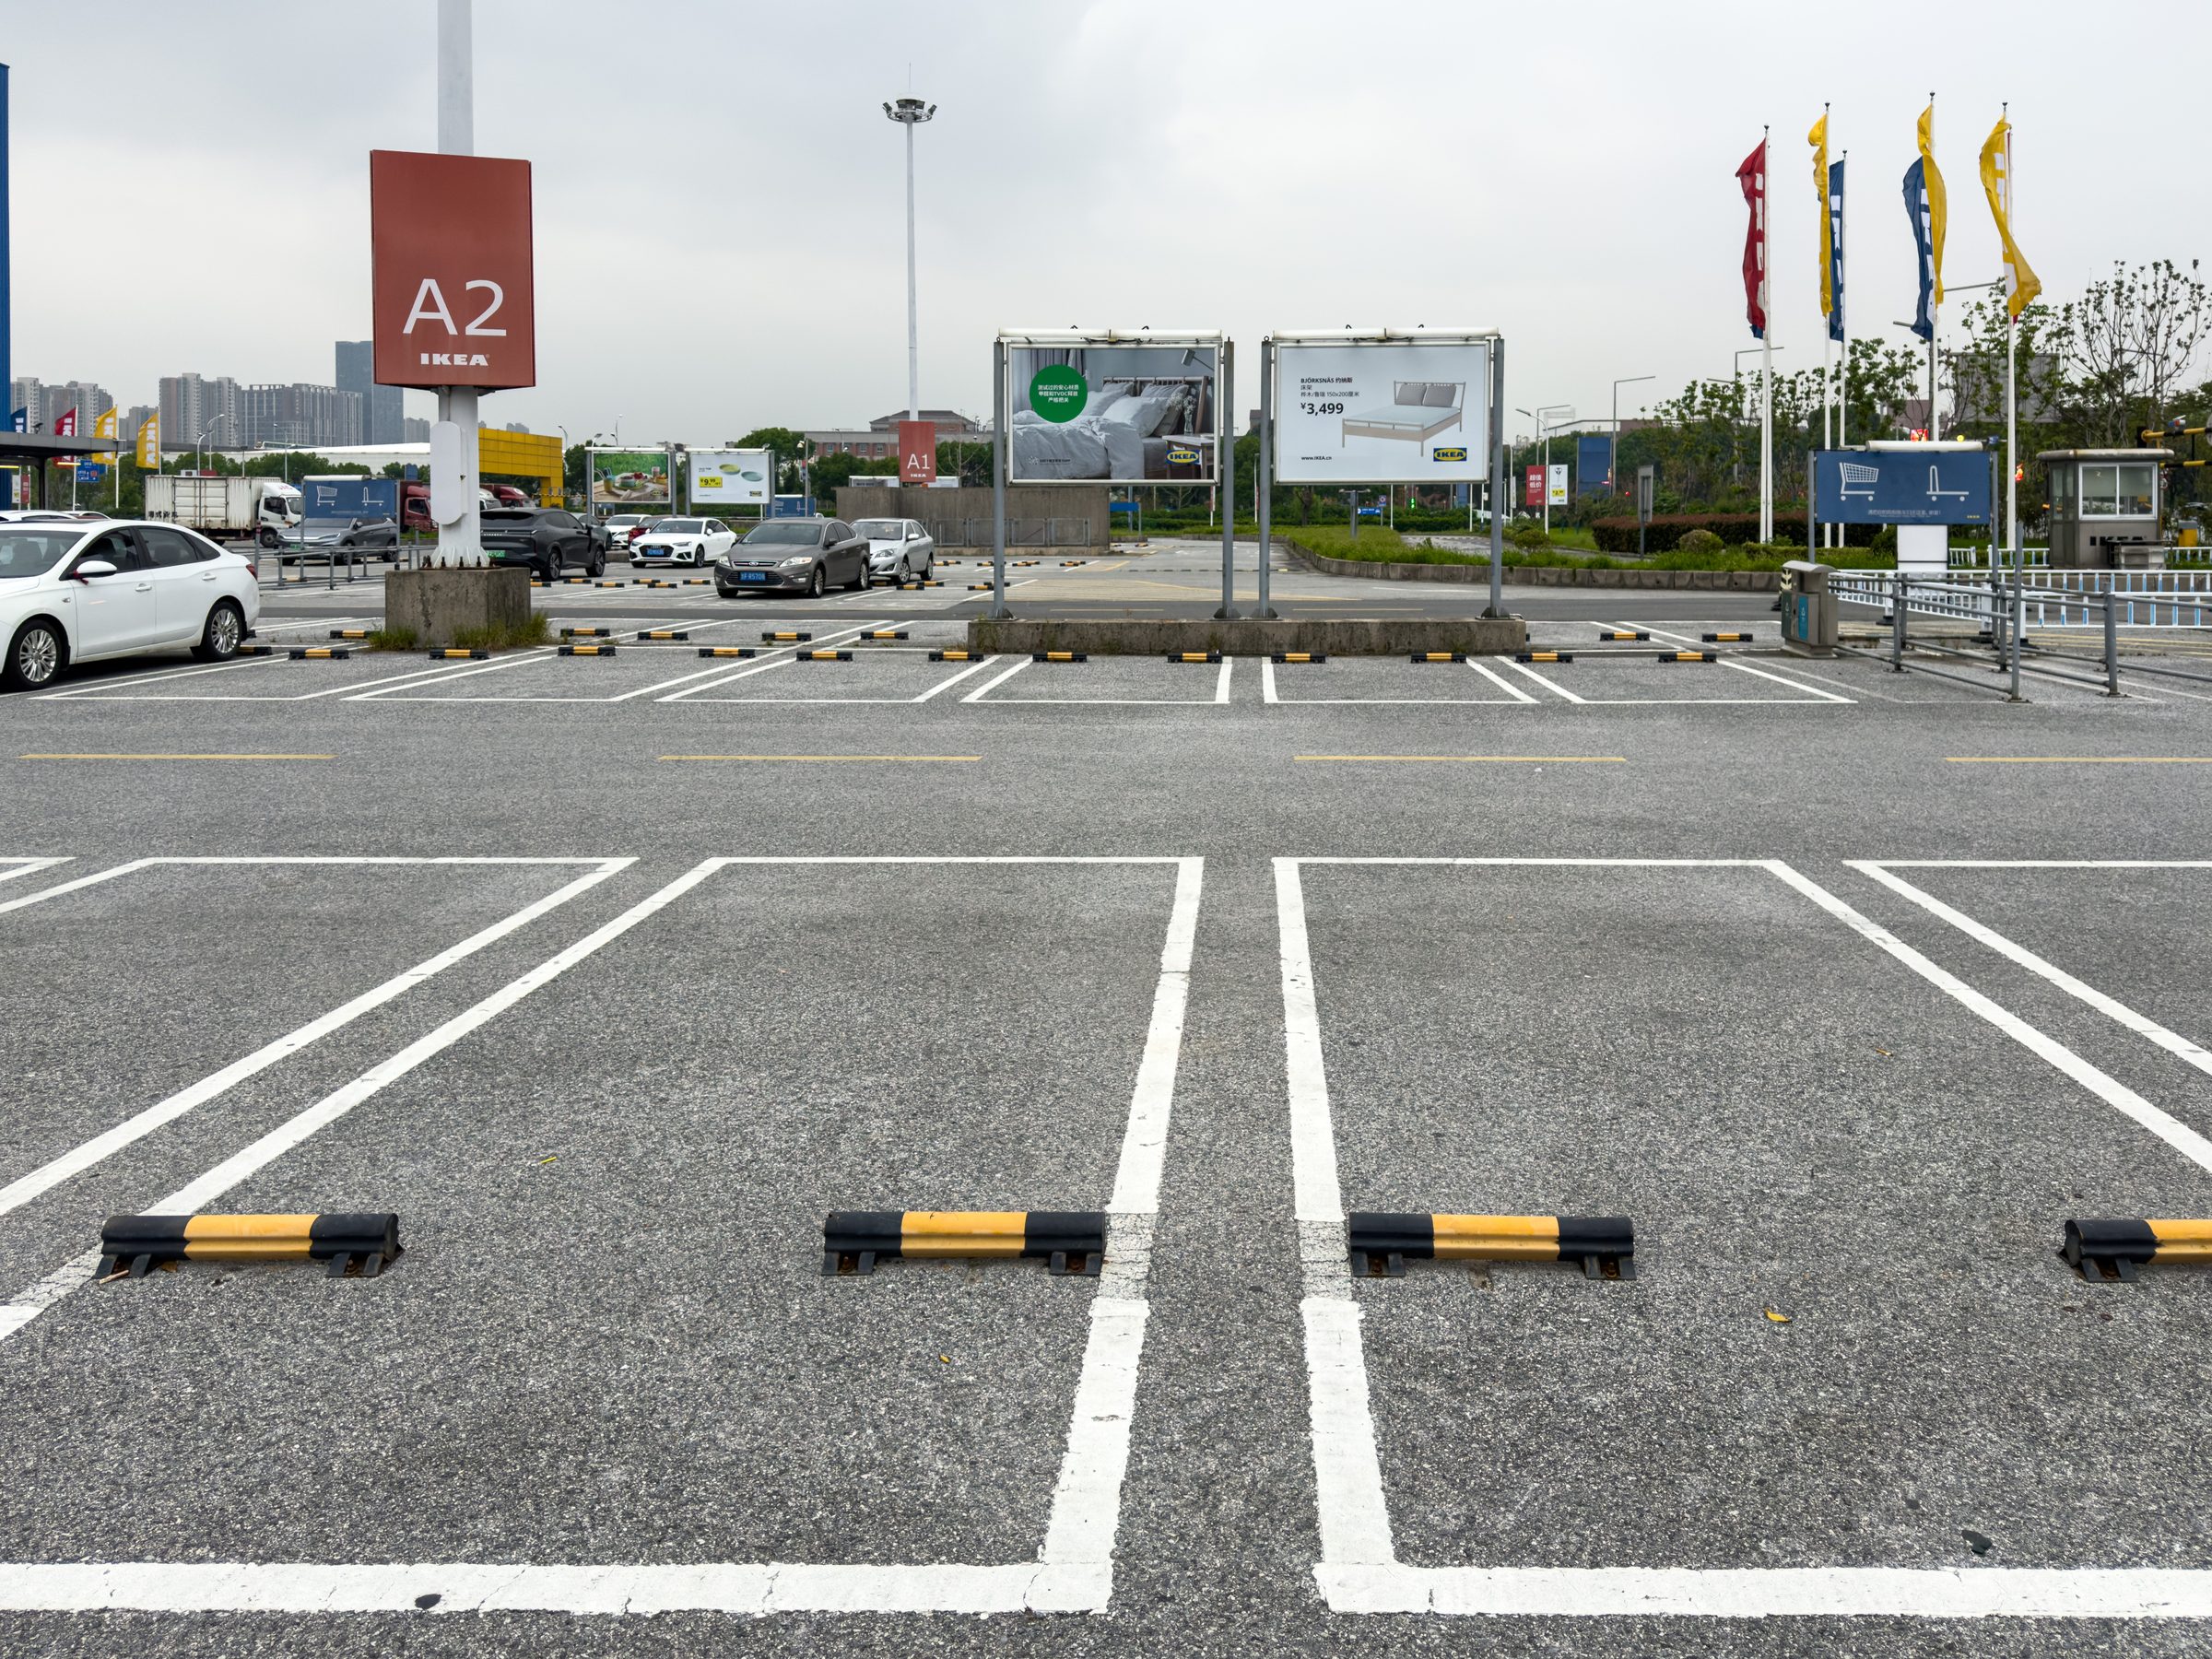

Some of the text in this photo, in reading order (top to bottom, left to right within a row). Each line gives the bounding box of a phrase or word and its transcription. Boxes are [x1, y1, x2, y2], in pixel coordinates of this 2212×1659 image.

[403, 278, 507, 336] A2
[420, 353, 488, 366] IKEA
[1300, 402, 1344, 416] ¥3,499
[907, 453, 930, 469] A1
